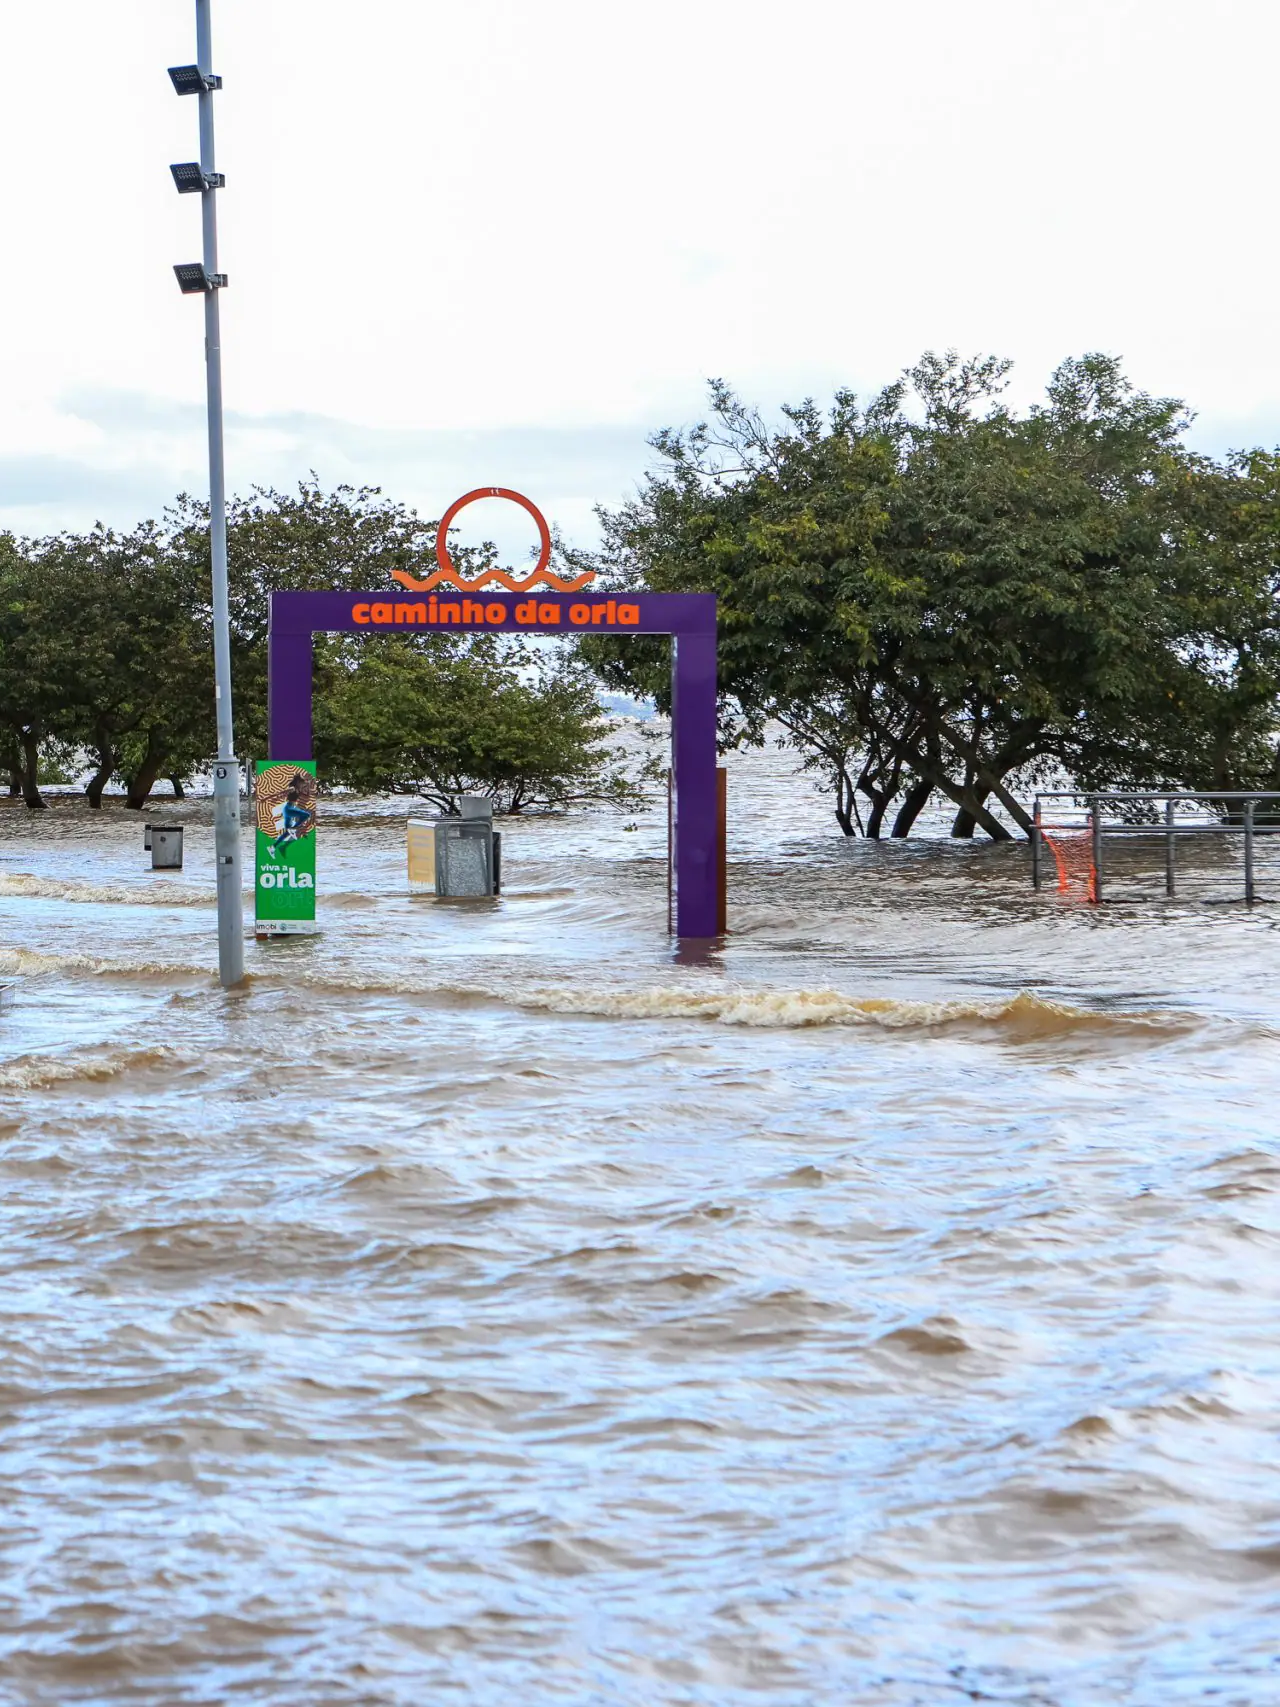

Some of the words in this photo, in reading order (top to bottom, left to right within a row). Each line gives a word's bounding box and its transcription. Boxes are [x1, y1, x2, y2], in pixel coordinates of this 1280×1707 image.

[352, 595, 507, 624] caminho
[515, 600, 561, 624] da
[569, 601, 640, 625] orla
[260, 867, 314, 888] orla
